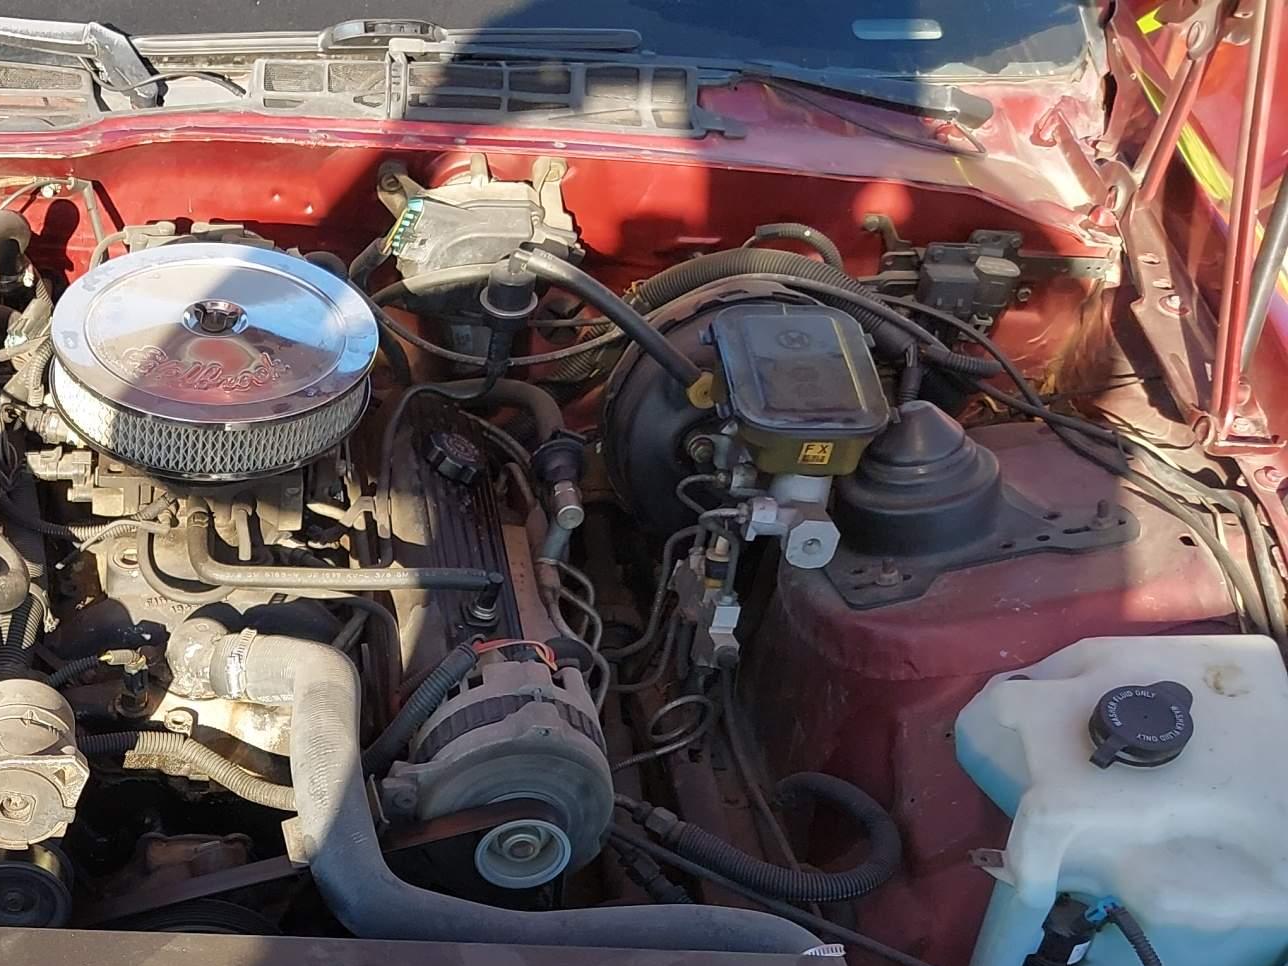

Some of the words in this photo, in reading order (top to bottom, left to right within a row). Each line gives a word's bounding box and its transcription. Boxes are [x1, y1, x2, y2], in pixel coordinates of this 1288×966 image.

[1112, 690, 1134, 703] FLUID
[1134, 689, 1157, 699] ONLY
[1107, 701, 1123, 727] WASHER
[1135, 733, 1158, 742] ONLY
